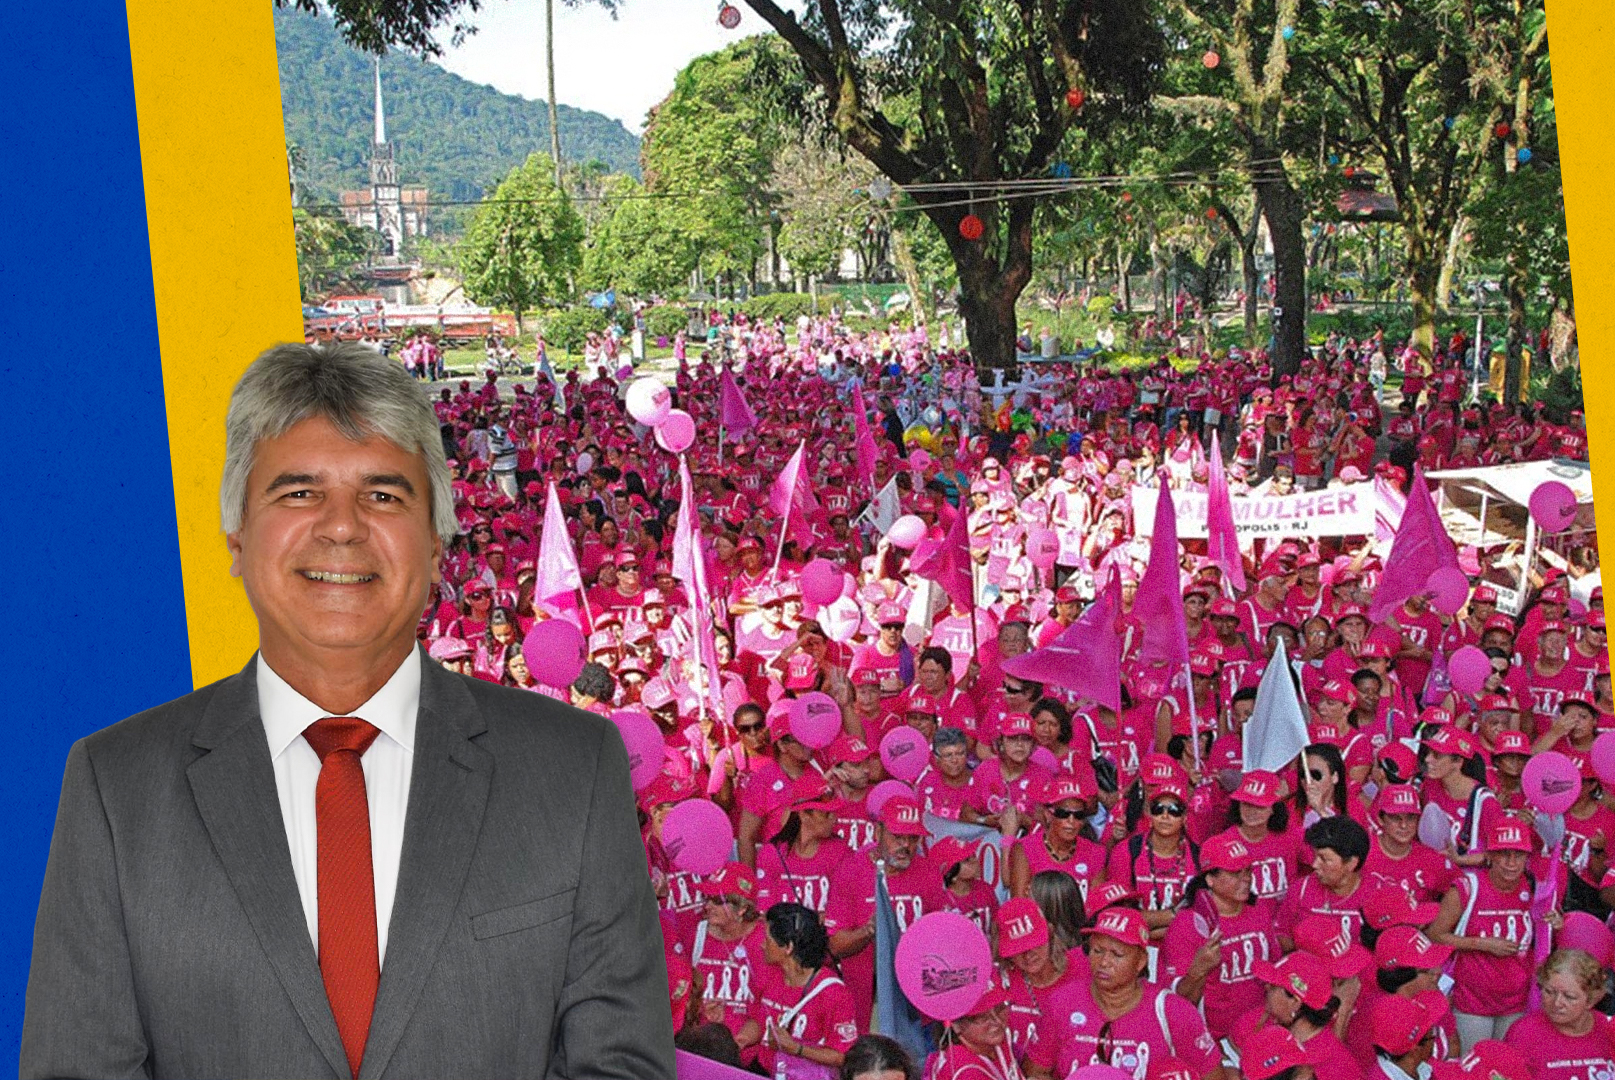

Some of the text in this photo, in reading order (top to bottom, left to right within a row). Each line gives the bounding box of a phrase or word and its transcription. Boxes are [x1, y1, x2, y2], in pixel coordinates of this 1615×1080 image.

[1233, 492, 1358, 520] MULHER
[1201, 521, 1309, 533] POPOLIS RJ
